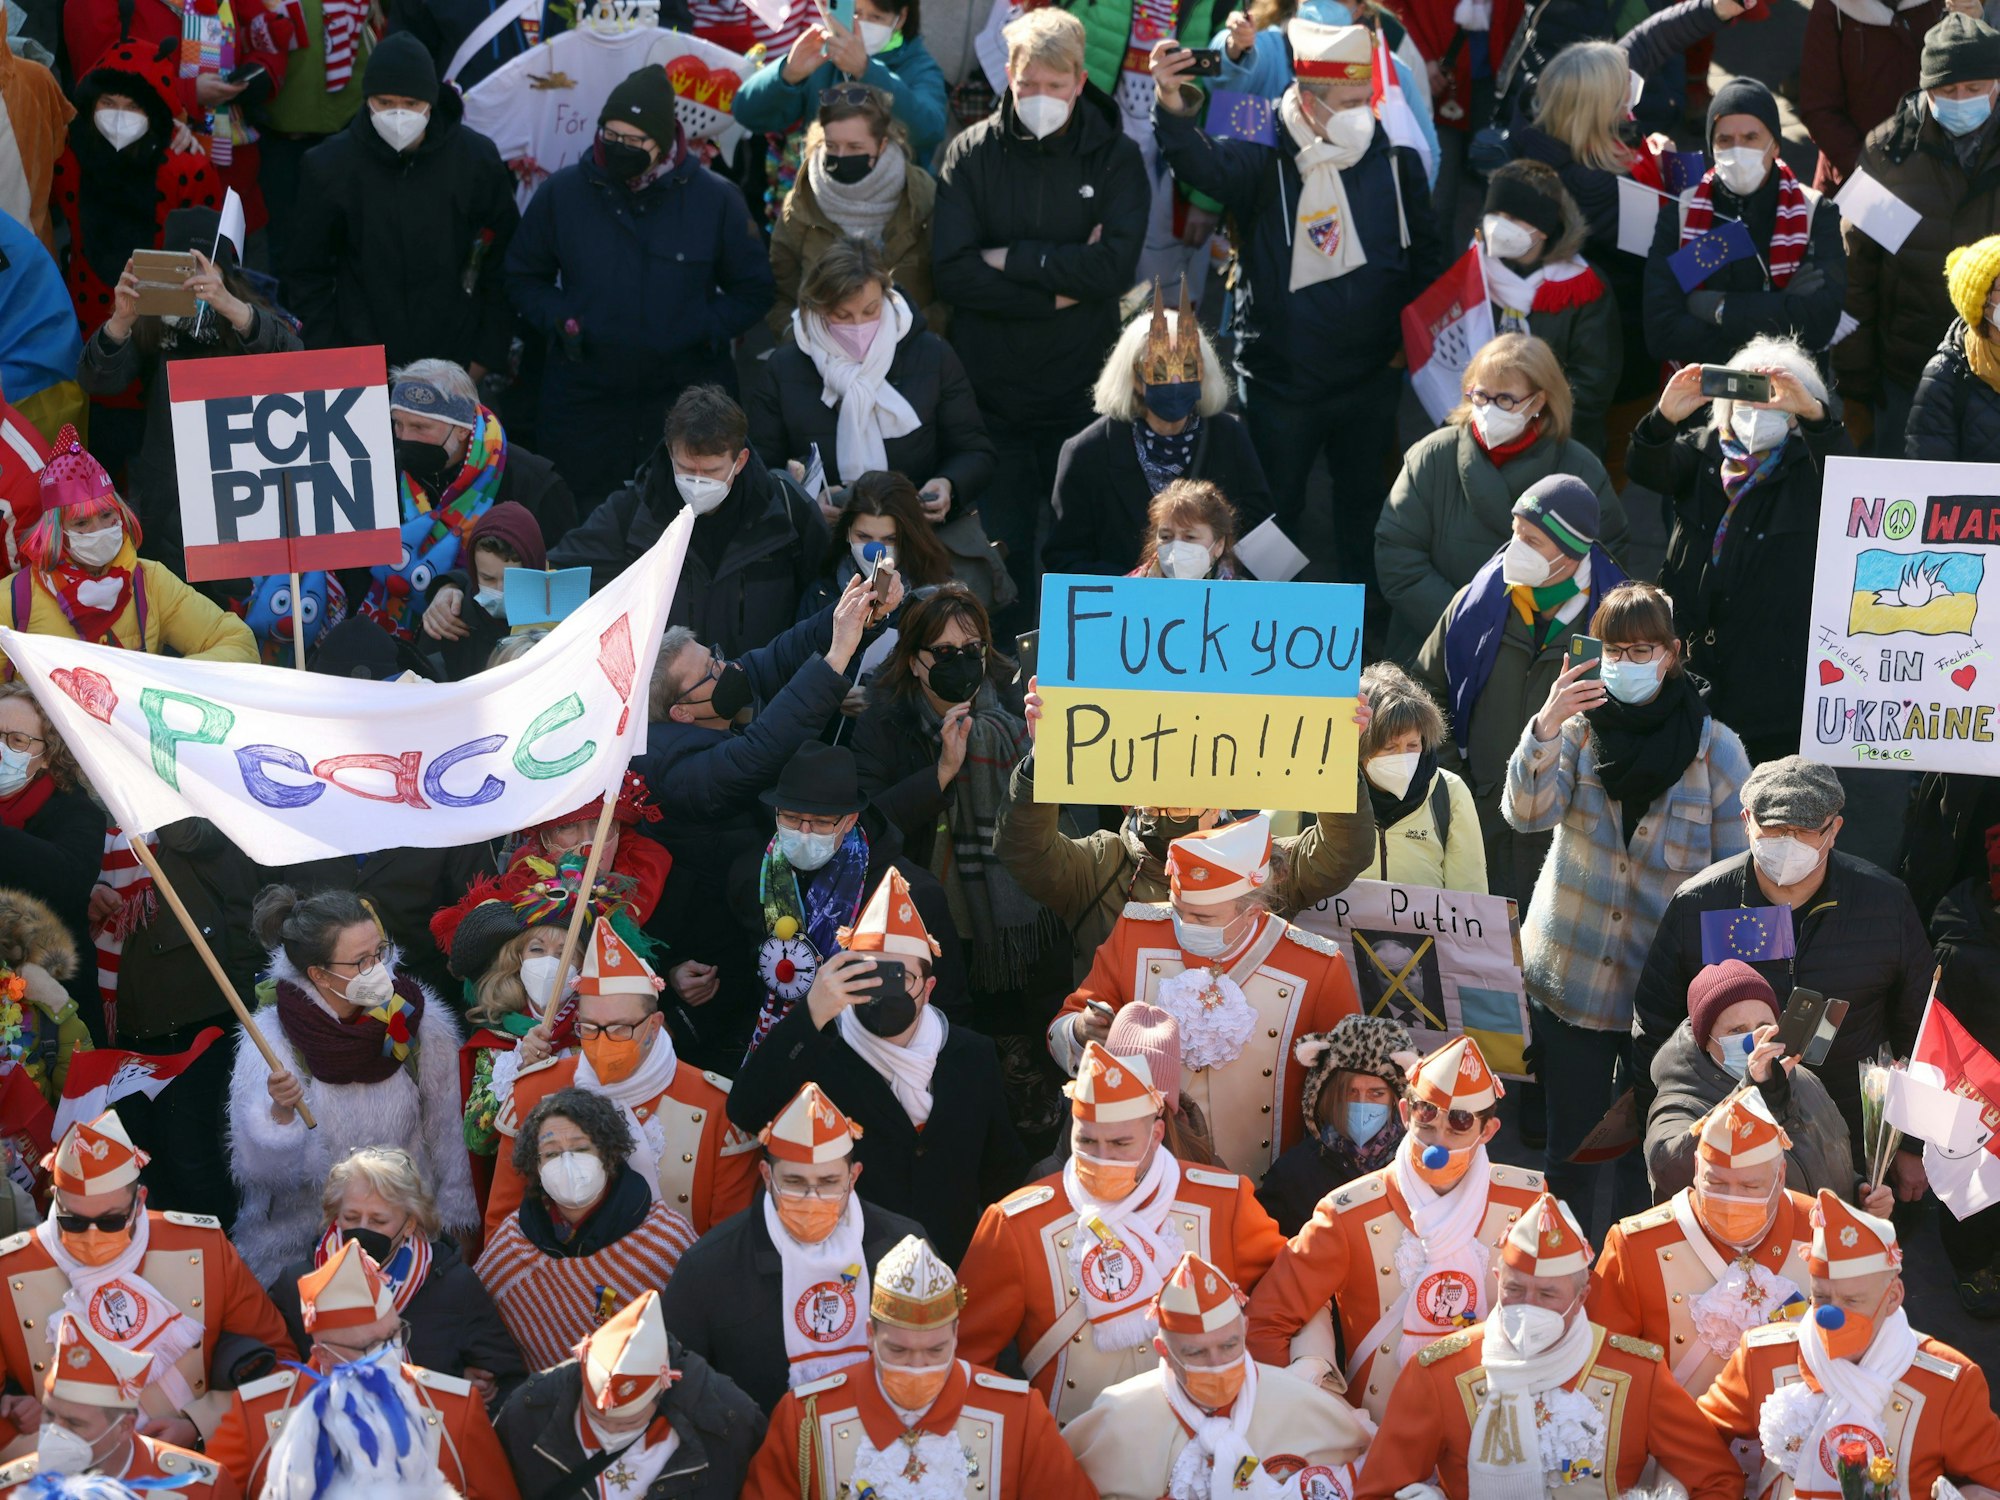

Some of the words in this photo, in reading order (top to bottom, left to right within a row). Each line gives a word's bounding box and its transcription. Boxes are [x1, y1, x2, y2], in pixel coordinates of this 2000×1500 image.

[205, 386, 371, 472] FCK
[212, 459, 376, 545] PTN
[1846, 497, 1916, 540] NO
[1067, 586, 1229, 681] Fuck
[1251, 620, 1359, 676] you
[1818, 625, 1869, 683] Frieden
[1934, 639, 1984, 671] Freiheit
[1067, 704, 1332, 785] Putin!!!
[1851, 743, 1915, 761] Peace
[1391, 888, 1482, 937] Putin
